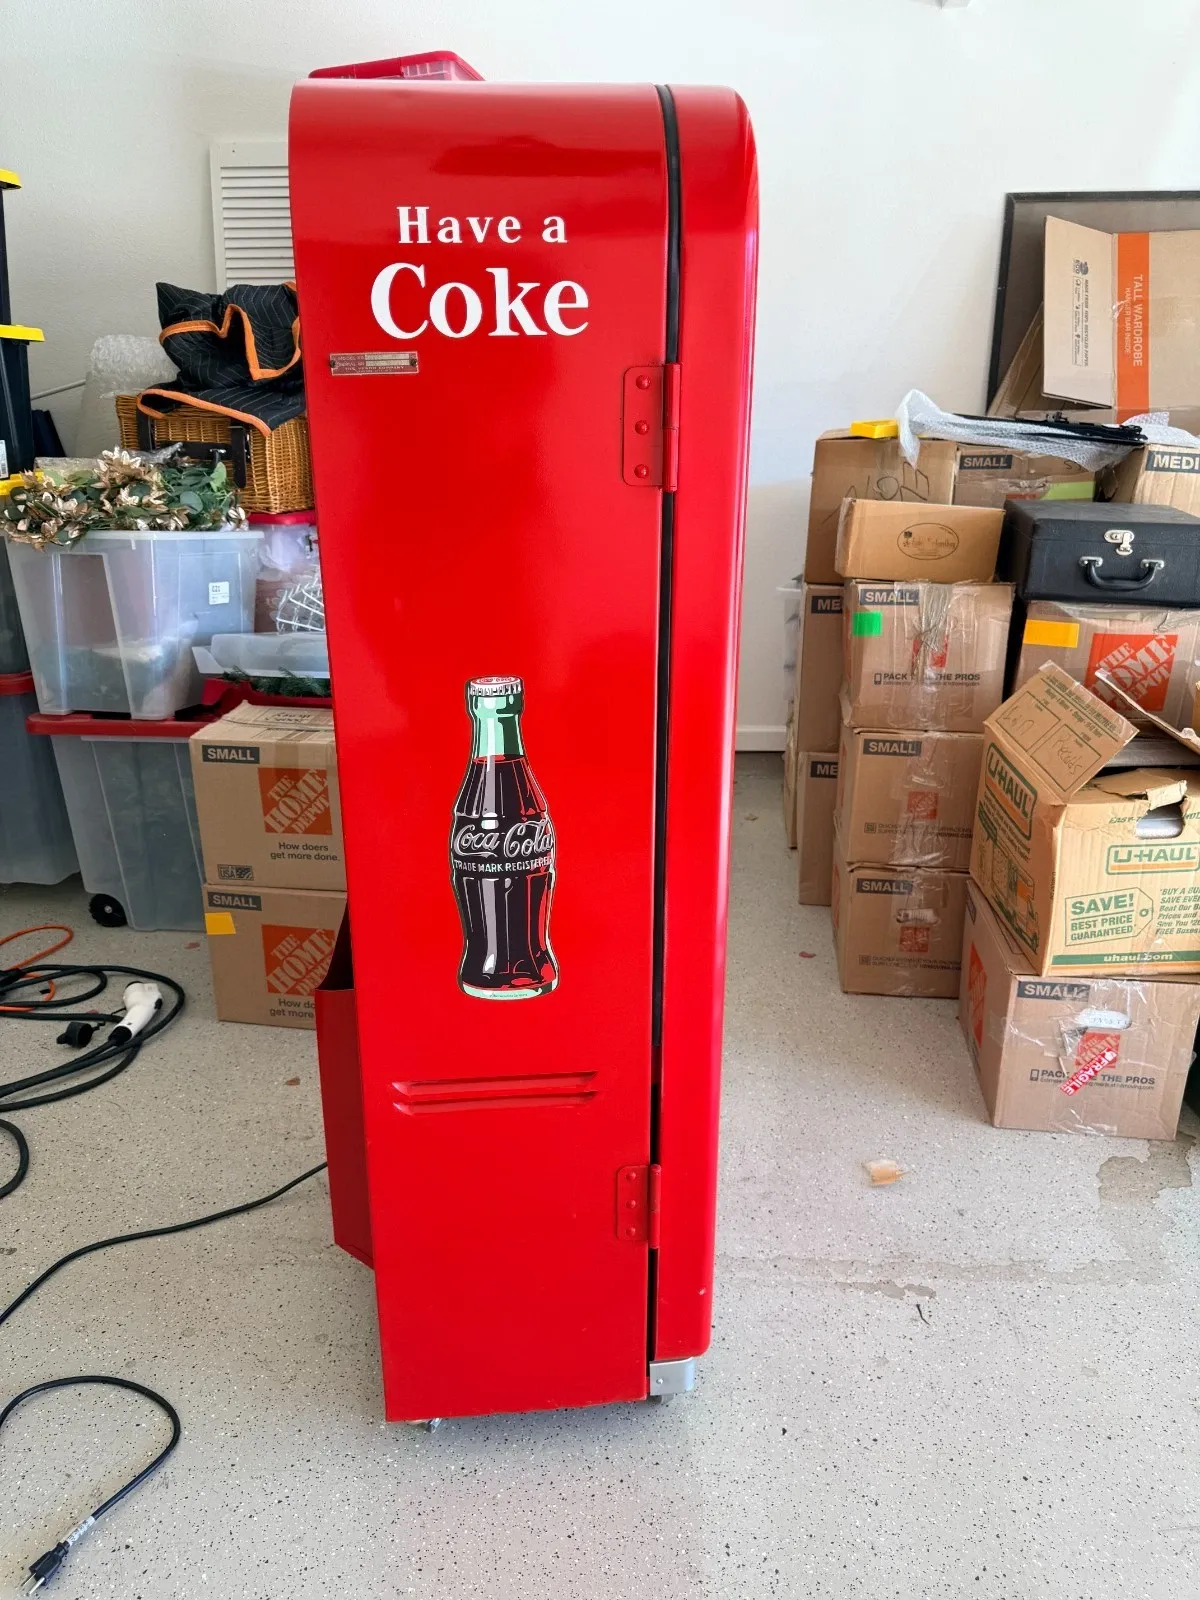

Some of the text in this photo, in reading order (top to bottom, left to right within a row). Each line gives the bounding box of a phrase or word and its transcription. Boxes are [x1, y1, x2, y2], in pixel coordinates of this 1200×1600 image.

[397, 206, 568, 243] Have a
[371, 262, 589, 339] Coke
[1133, 274, 1143, 366] TALL WARDROBE
[963, 457, 1007, 467] SMALL
[1153, 455, 1200, 470] MEDI
[865, 591, 914, 603] SMALL
[817, 599, 841, 611] ME
[1096, 642, 1135, 671] THE
[208, 748, 255, 761] SMALL
[868, 742, 916, 754] SMALL
[817, 764, 838, 775] ME
[268, 776, 295, 804] THE
[988, 752, 1030, 819] U-HAUL
[265, 768, 328, 834] HOME
[290, 795, 329, 835] DEPOT
[278, 842, 329, 852] How doers
[270, 852, 341, 861] get more done.
[1114, 847, 1196, 863] U-HAUL
[454, 859, 477, 872] TRADE
[478, 863, 504, 873] MARK
[862, 881, 908, 892] SMALL
[1179, 887, 1185, 895] A
[213, 894, 257, 908] SMALL
[1071, 893, 1134, 916] SAVE!
[1160, 896, 1182, 904] SAVE
[1159, 904, 1178, 912] Beat
[1071, 914, 1133, 932] BEST PRICE
[1157, 912, 1182, 920] Prices
[1070, 925, 1133, 941] GUARANTEED
[272, 934, 299, 965] THE
[267, 929, 334, 995] HOME
[1104, 953, 1173, 963] uhaul.com
[1024, 984, 1082, 999] SMALL
[278, 998, 298, 1008] How
[270, 1008, 314, 1018] get more
[1063, 1054, 1108, 1097] FRAGILE
[1101, 1074, 1123, 1083] THE
[1125, 1075, 1156, 1085] PROS
